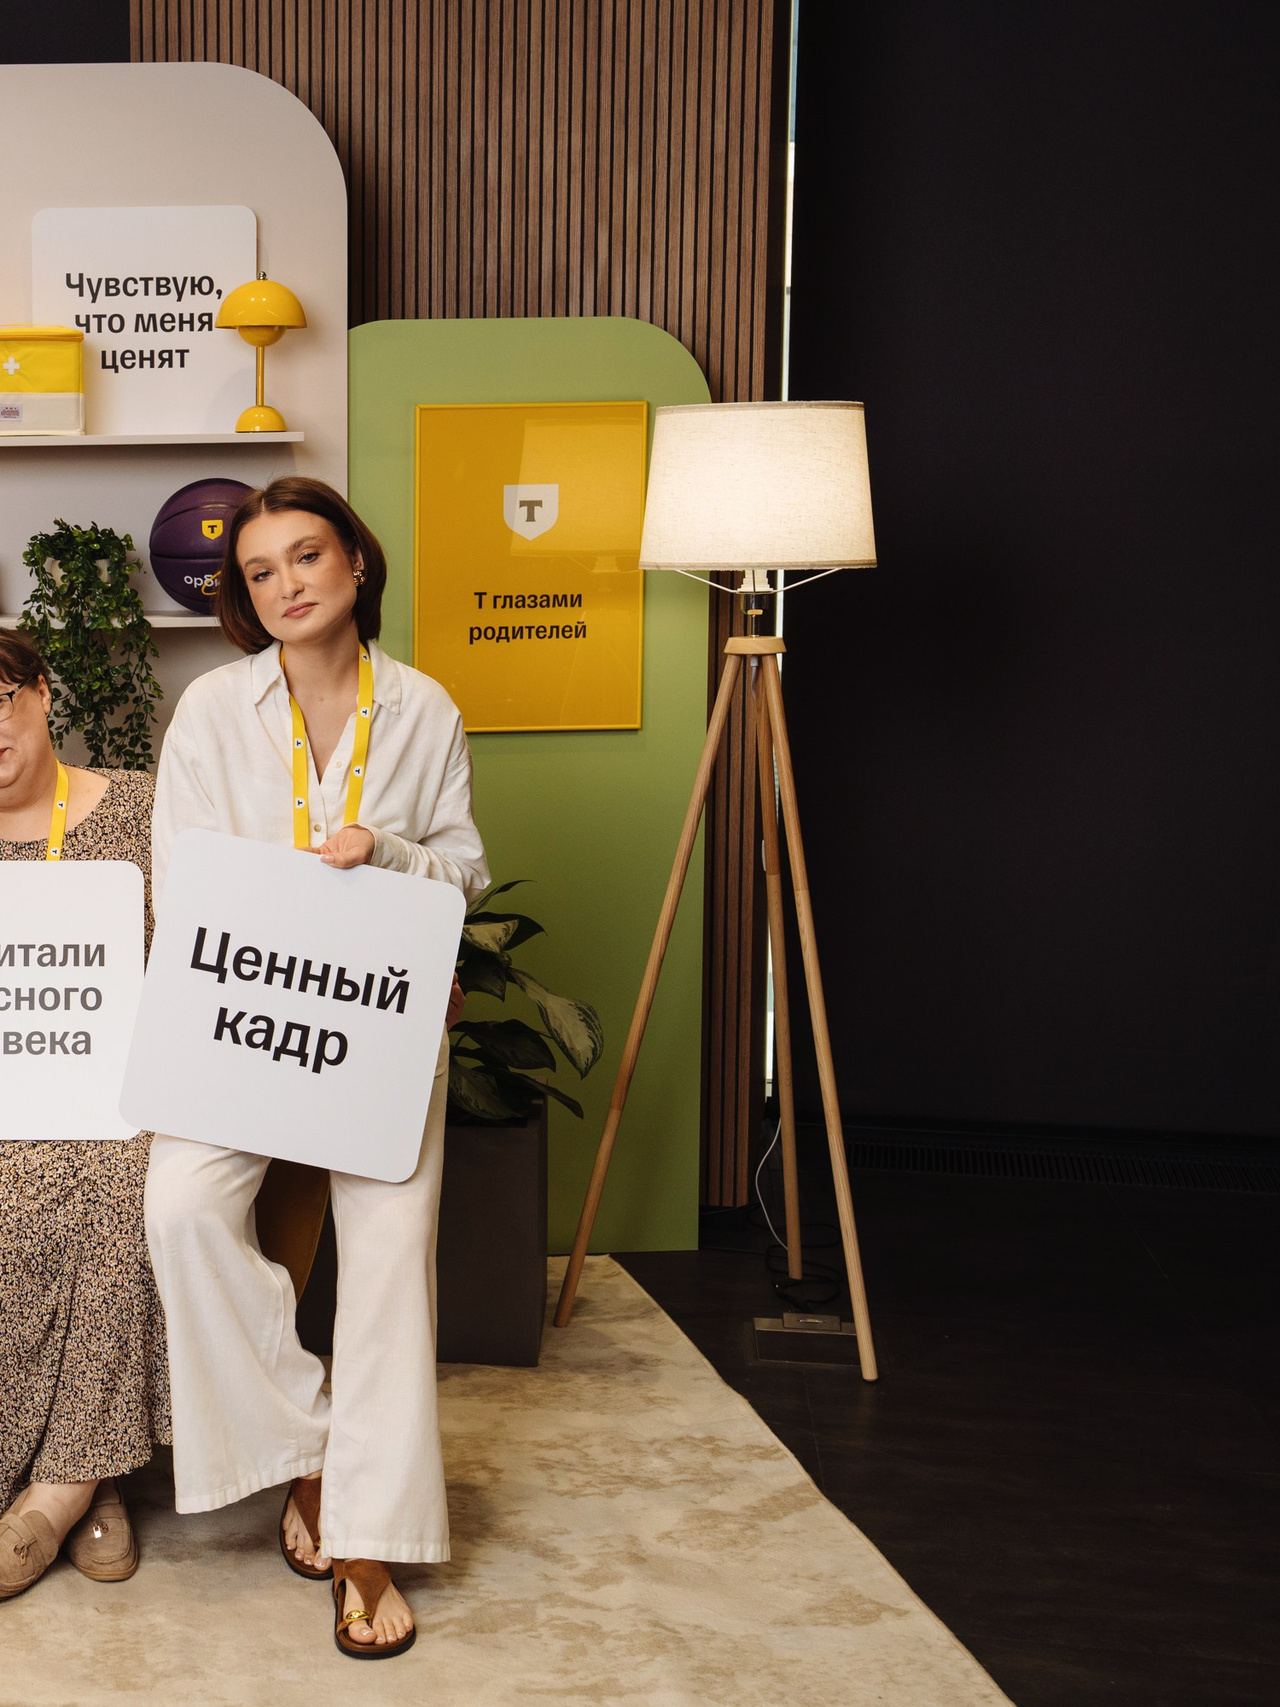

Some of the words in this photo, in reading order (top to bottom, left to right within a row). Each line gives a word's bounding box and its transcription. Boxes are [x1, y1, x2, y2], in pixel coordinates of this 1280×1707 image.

[66, 273, 223, 302] Чувствую,
[75, 314, 125, 333] что
[134, 313, 212, 332] меня
[102, 349, 189, 373] ценят
[519, 500, 542, 522] Т
[474, 592, 487, 609] Т
[493, 593, 582, 610] глазами
[469, 621, 587, 645] родителей
[190, 927, 411, 1014] Ценный
[213, 1007, 352, 1074] кадр
